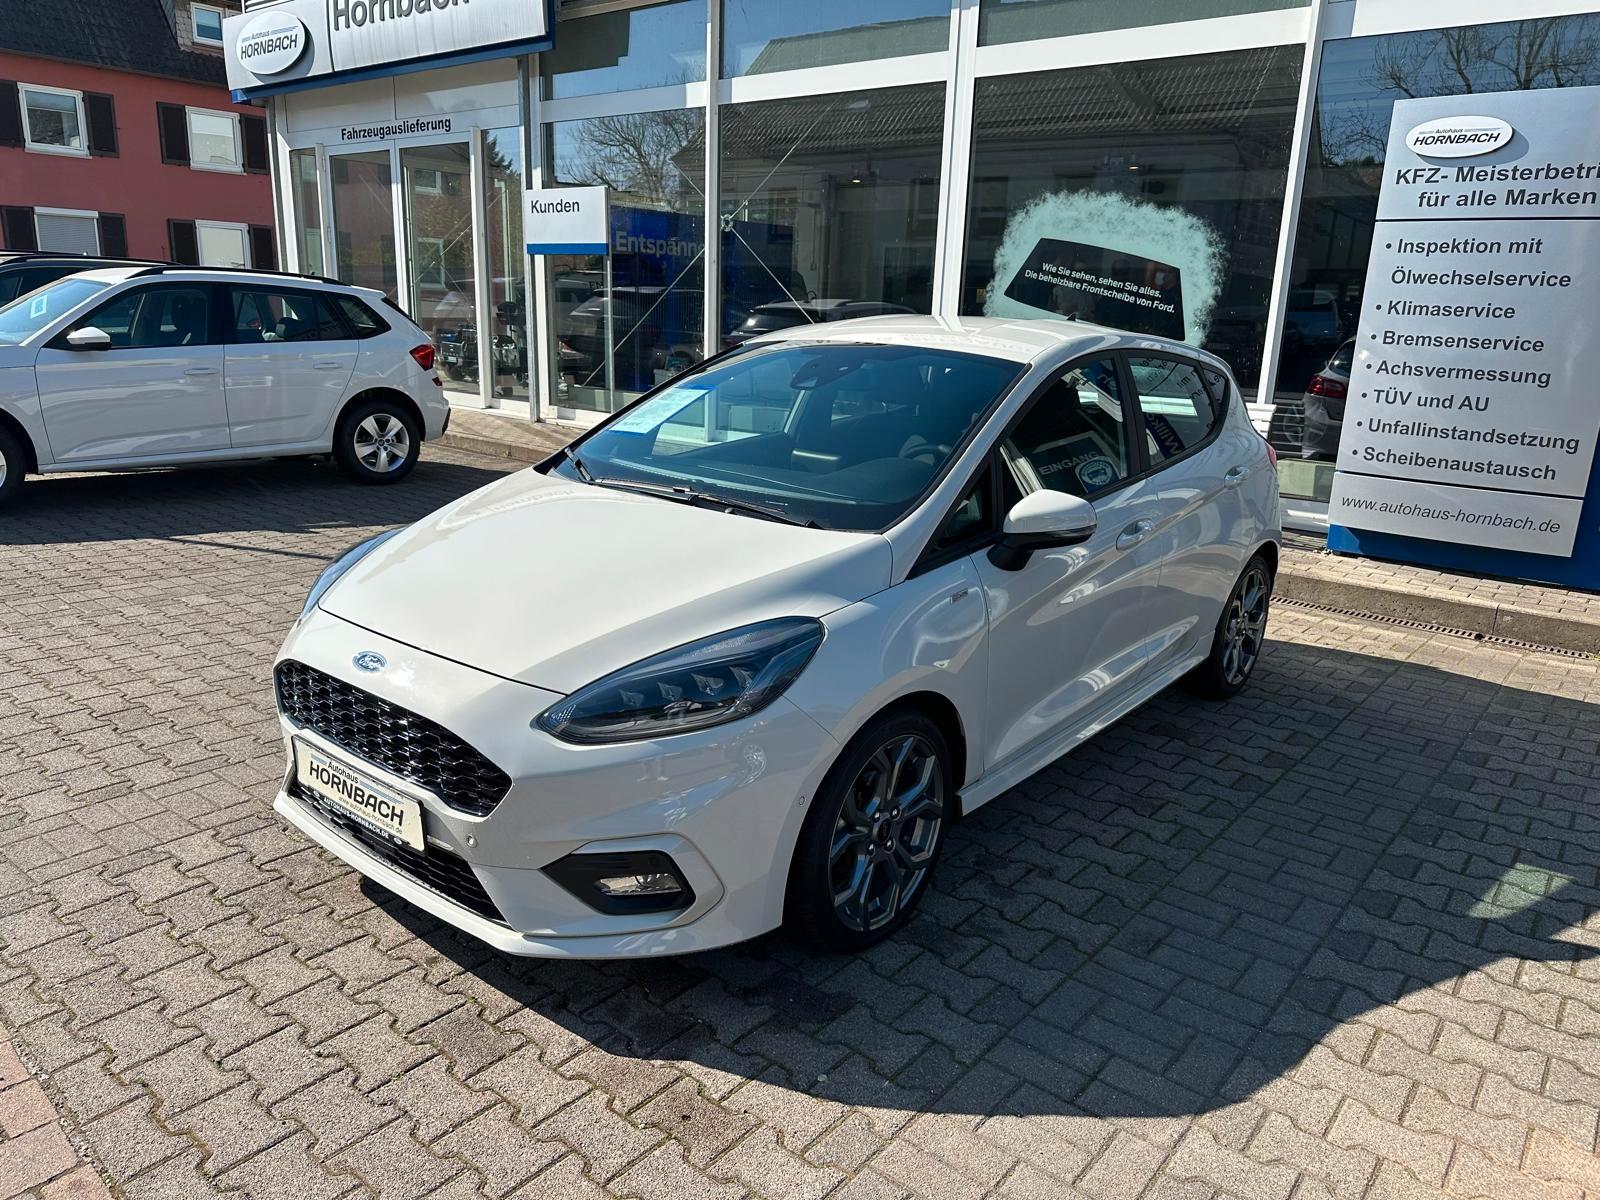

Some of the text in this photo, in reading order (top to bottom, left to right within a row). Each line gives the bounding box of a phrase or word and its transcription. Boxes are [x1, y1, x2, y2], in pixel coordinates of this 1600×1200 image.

[334, 0, 471, 31] Horna
[240, 33, 298, 60] HORNBACH
[341, 117, 451, 141] Fahrzeugauslieferung
[1413, 132, 1501, 146] HORNBACH
[1395, 167, 1449, 185] KFZ-
[531, 199, 580, 214] Kunden
[1418, 188, 1598, 208] für alle Marken
[1397, 237, 1543, 257] Inspektion mit
[1042, 262, 1163, 299] Wie Sie sehen, sehen Sie alles.
[1391, 266, 1572, 287] Ölwechselservice
[1024, 269, 1176, 313] Die beheizbare Frontscheibe von Ford.
[1387, 300, 1516, 319] Klimaservice
[1382, 330, 1545, 353] Bremsenservice
[1376, 360, 1552, 389] Achsvermessung
[1373, 387, 1490, 412] TÜV und AU
[1368, 417, 1580, 455] Unfallinstandsetzung
[1363, 446, 1557, 481] Scheibenaustausch
[1341, 497, 1561, 534] www.autohaus-hornbach.de
[327, 761, 359, 784] Autohaus
[309, 760, 405, 827] HORNBACH
